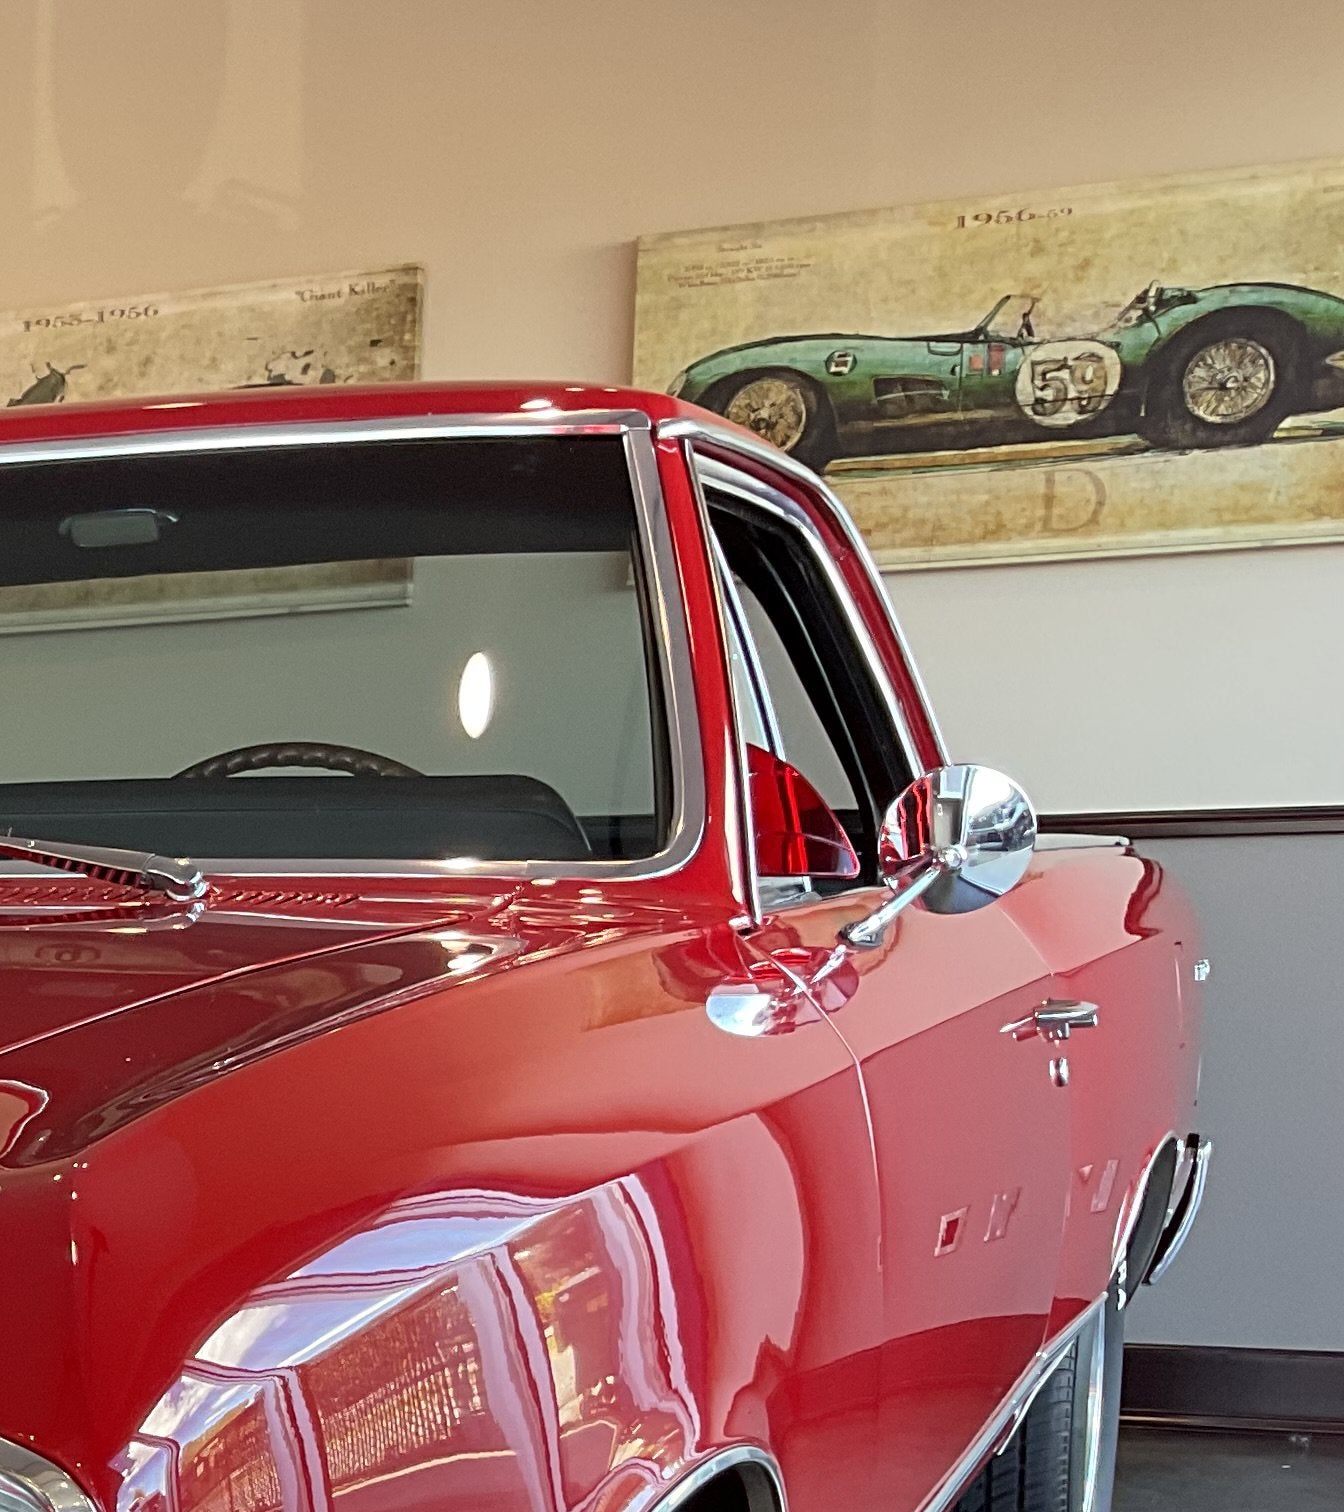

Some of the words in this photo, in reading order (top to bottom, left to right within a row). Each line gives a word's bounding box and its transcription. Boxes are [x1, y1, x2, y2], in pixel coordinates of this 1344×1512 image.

[955, 207, 1073, 229] 1956-59
[1031, 352, 1108, 417] 59
[1039, 468, 1107, 533] D
